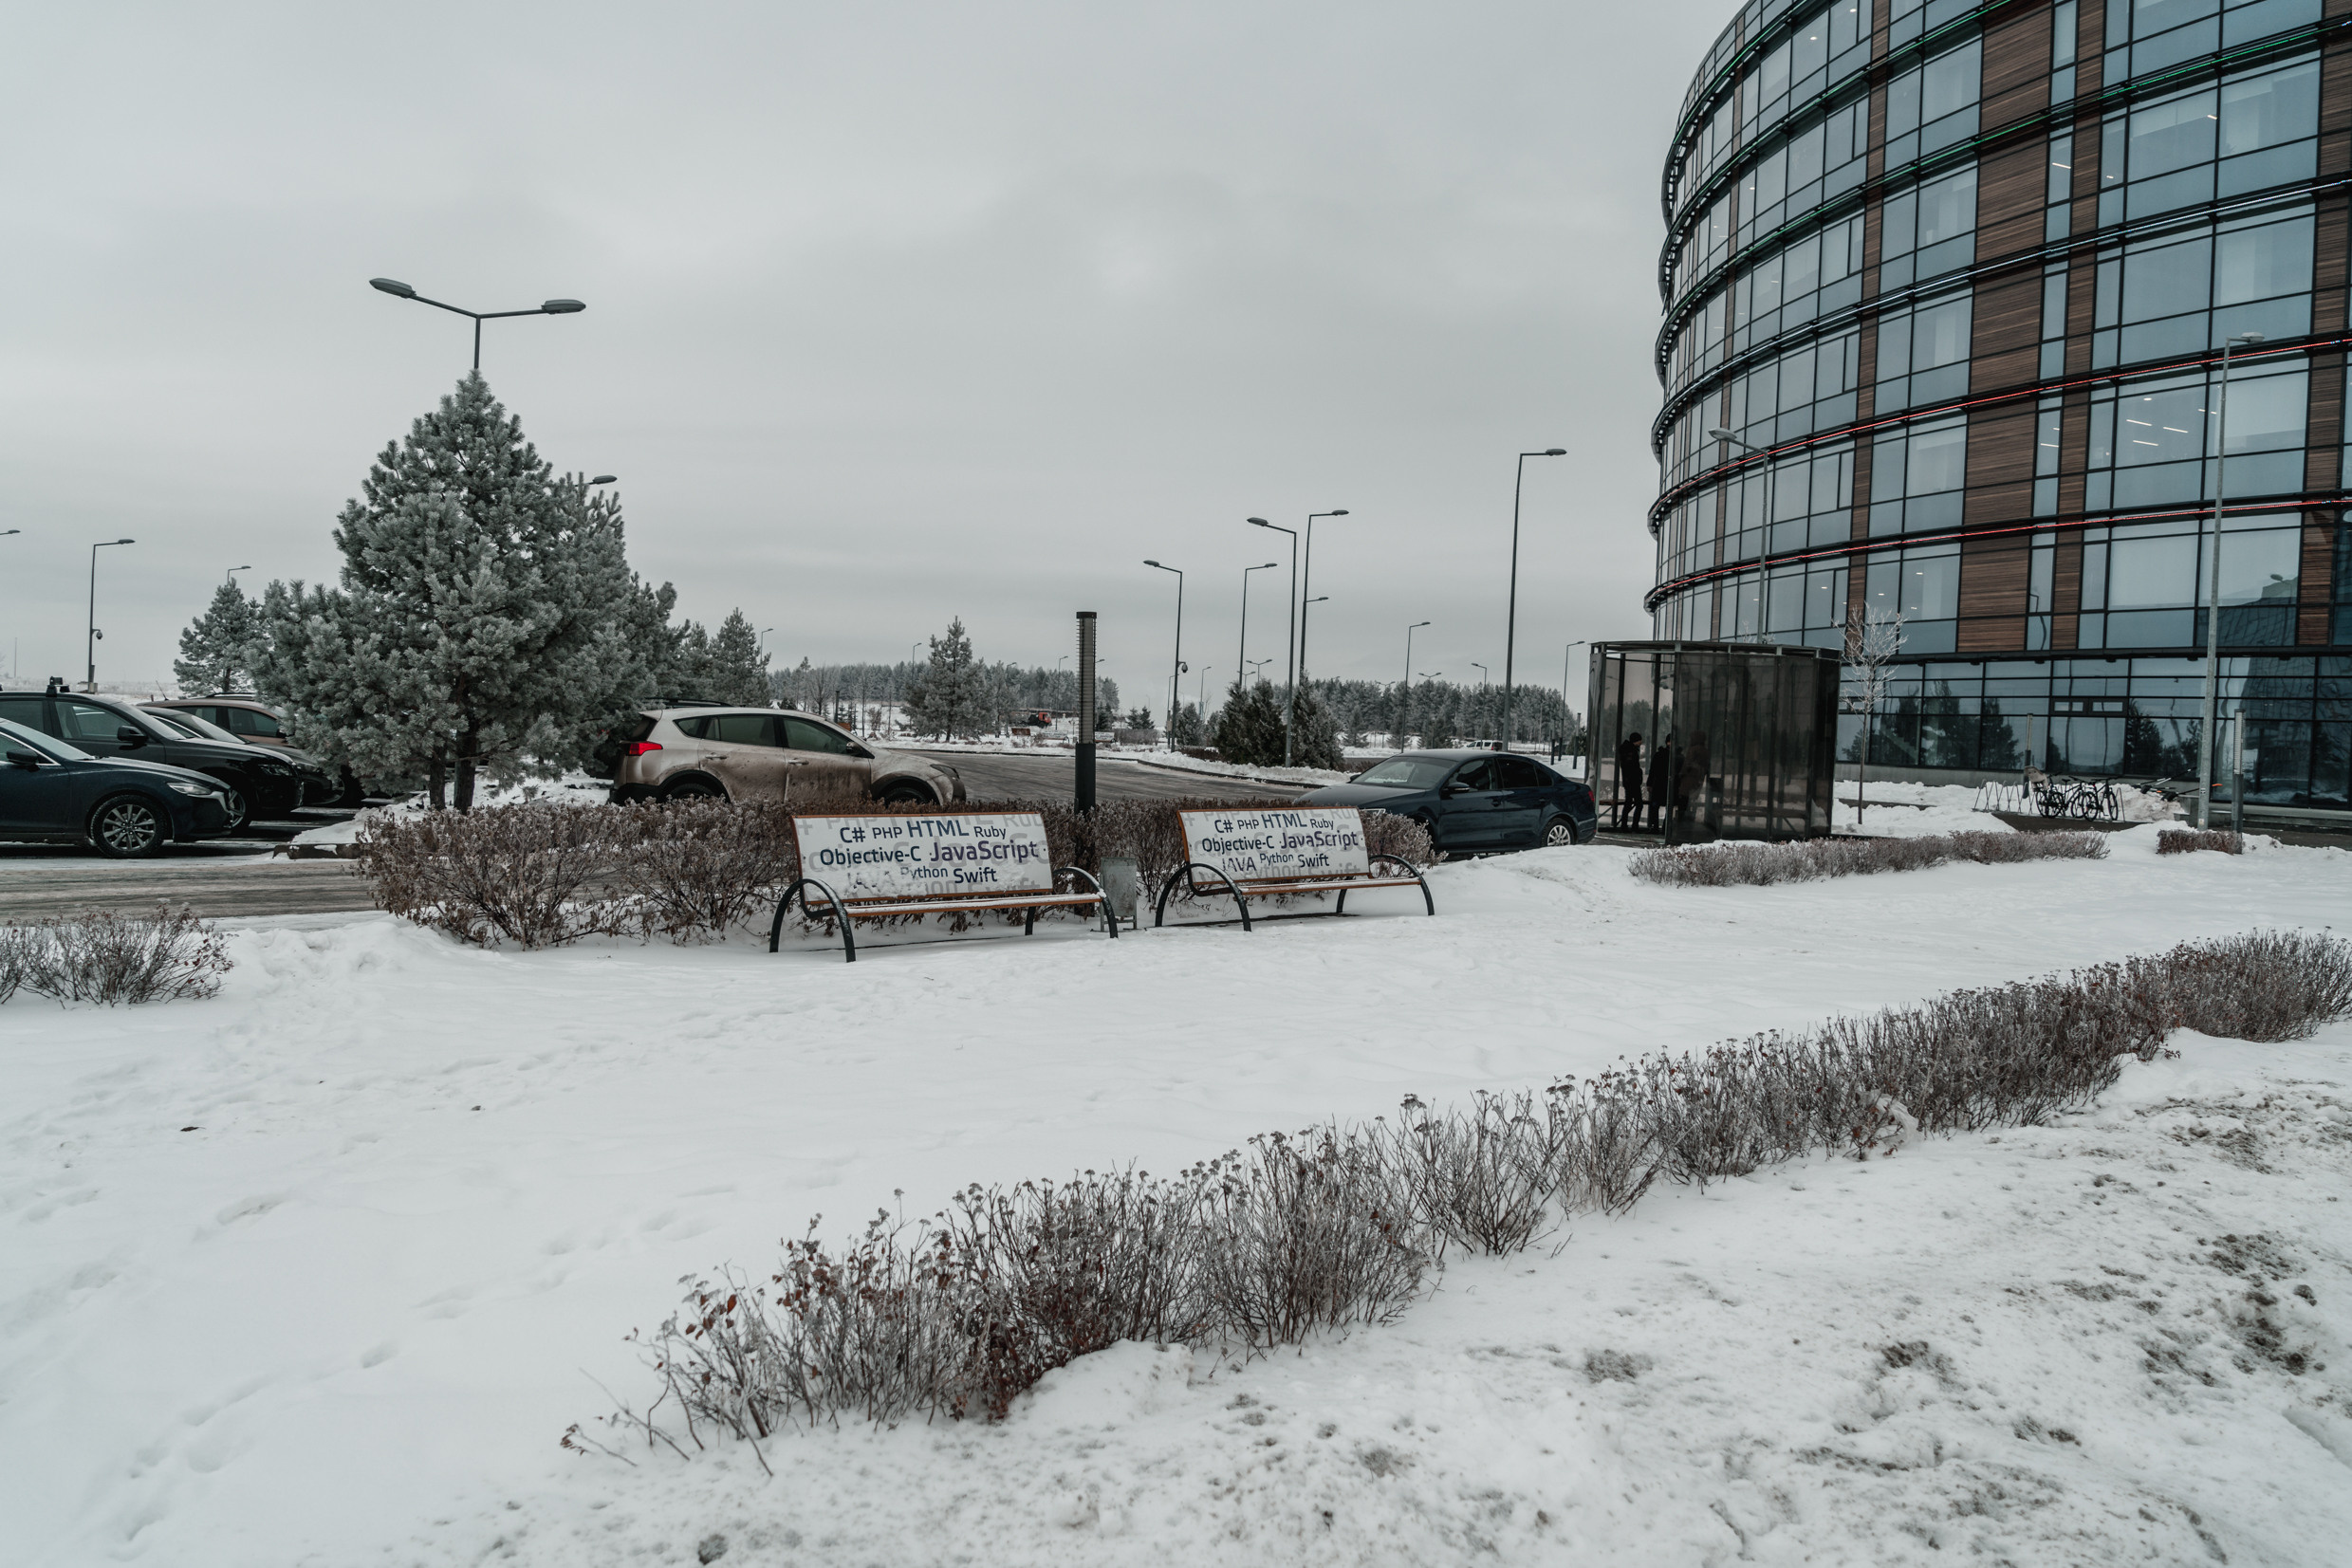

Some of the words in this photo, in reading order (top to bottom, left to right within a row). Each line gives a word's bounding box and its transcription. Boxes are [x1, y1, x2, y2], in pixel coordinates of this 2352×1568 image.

[840, 827, 865, 843] C#
[872, 827, 902, 839] PHP
[906, 820, 970, 838] HTML
[973, 825, 1007, 839] Ruby
[1214, 820, 1234, 833] C#
[1237, 819, 1259, 830] PHP
[1261, 813, 1307, 829] HTML
[1309, 818, 1334, 830] Ruby
[1202, 836, 1274, 855] Objective-C
[1281, 830, 1359, 850] JavaScript
[820, 845, 921, 869] Objective-C
[931, 839, 1039, 863] JavaScript
[1259, 852, 1293, 866] Python
[1298, 853, 1329, 868] Swift
[954, 867, 997, 883] Swift
